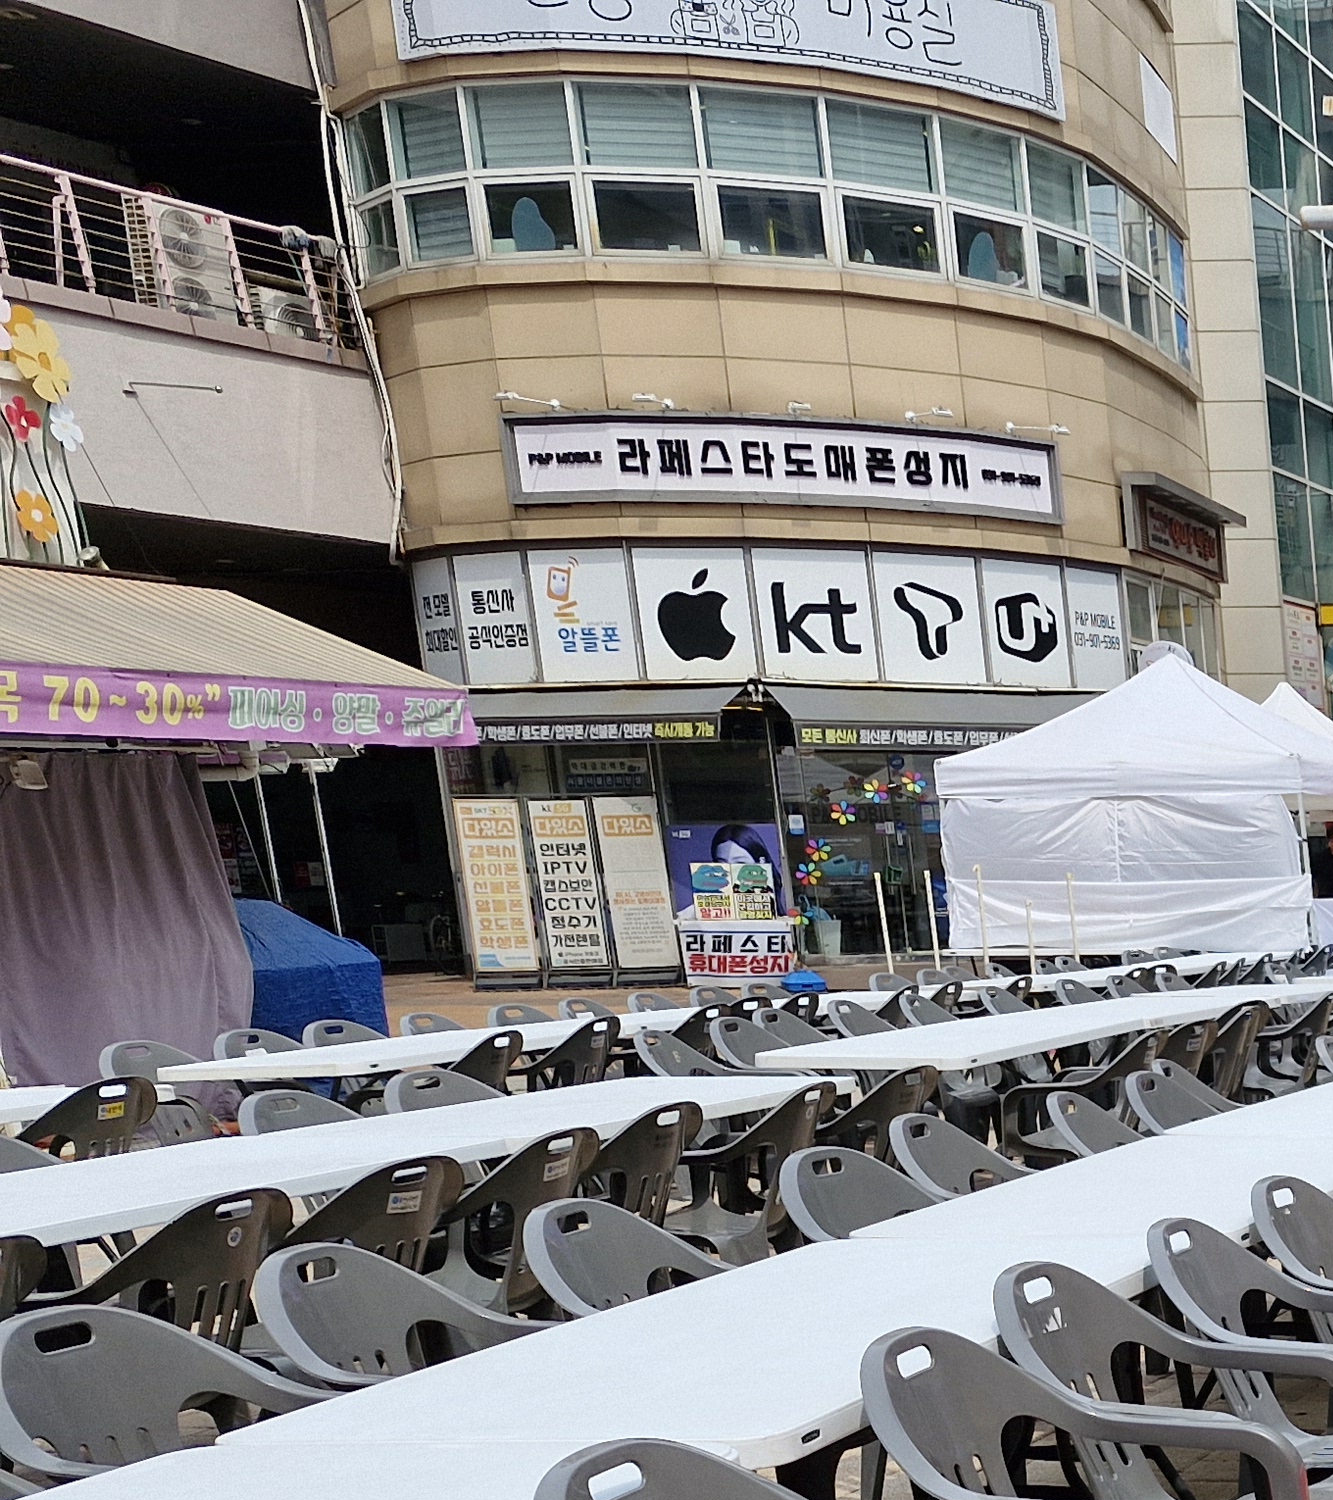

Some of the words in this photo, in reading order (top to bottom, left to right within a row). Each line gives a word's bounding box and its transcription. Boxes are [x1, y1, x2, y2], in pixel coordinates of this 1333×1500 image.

[555, 450, 603, 465] MOBILE
[470, 588, 515, 615] 통신사
[770, 581, 862, 655] kt
[1090, 613, 1116, 631] MOBILE
[467, 623, 530, 651] 공식인증점
[557, 626, 622, 653] 알뜰폰
[227, 687, 306, 731] 피어싱
[332, 693, 380, 735] 양말
[464, 819, 515, 837] 다있소
[535, 818, 584, 835] 다있소
[603, 817, 652, 835] 다있소
[539, 843, 587, 857] 인터넷
[470, 862, 519, 877] 아이폰
[542, 861, 588, 875] IPTV
[543, 879, 593, 894] 캡스보안
[544, 897, 597, 912] CCTV
[551, 916, 597, 930] 정수기
[551, 933, 601, 948] 가전렌탈
[688, 953, 791, 974] 휴대폰성지
